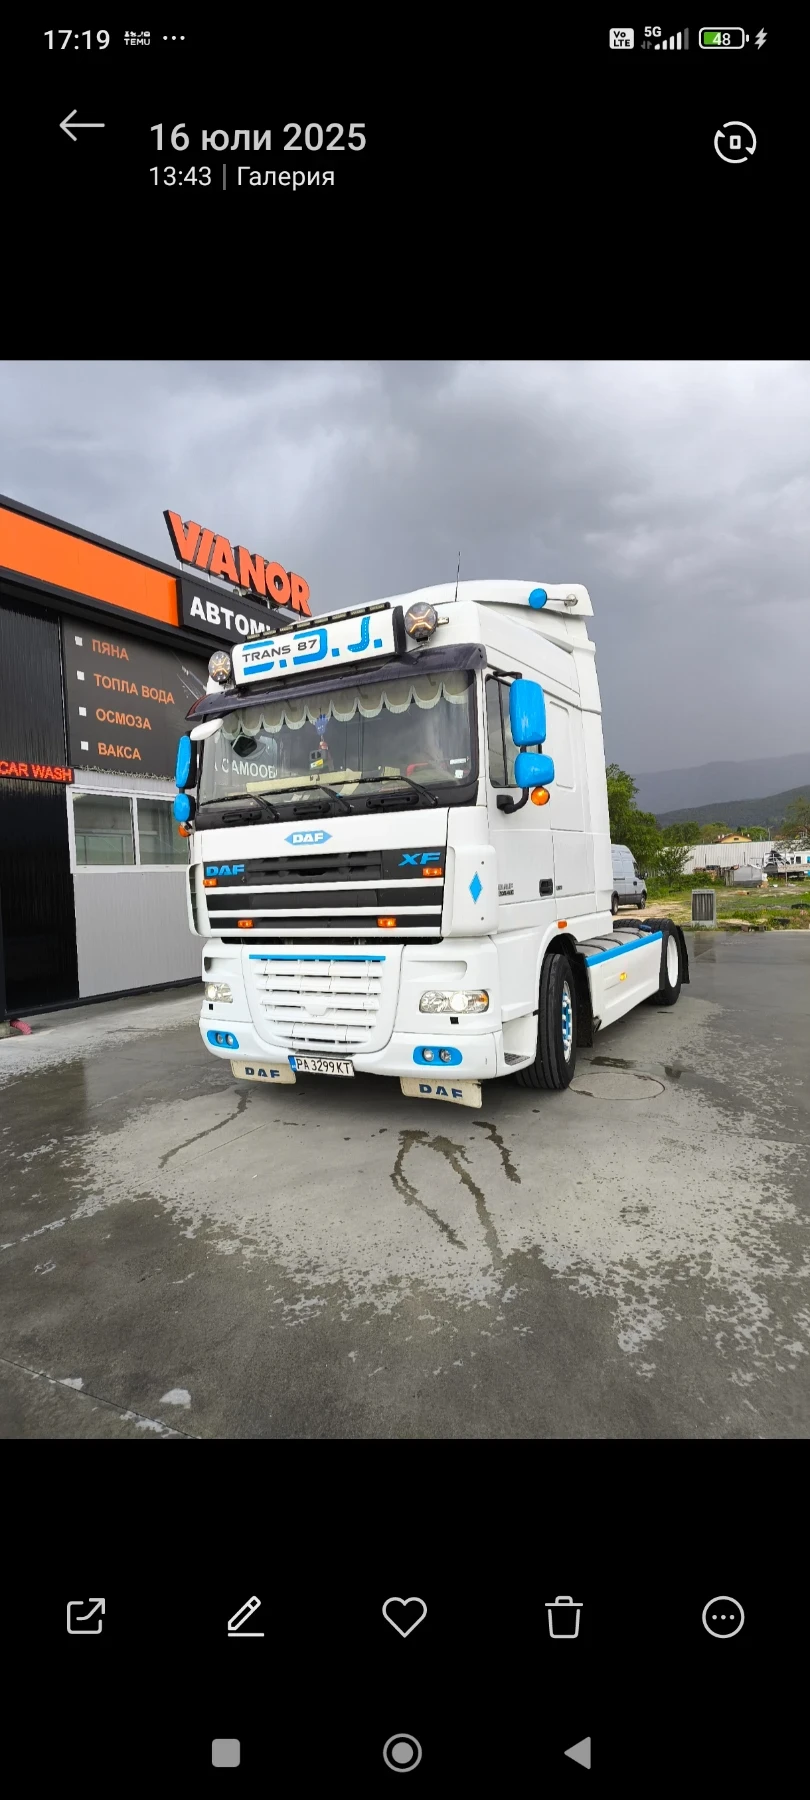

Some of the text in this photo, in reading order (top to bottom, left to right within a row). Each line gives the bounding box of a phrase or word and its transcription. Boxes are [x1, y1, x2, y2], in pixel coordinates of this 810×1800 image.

[164, 510, 312, 617] VIANOR
[190, 596, 271, 636] АВТОМ
[91, 638, 130, 661] ПЯНА
[242, 638, 318, 663] TRANS 87
[93, 673, 175, 704] ТОПЛА ВОДА
[95, 708, 152, 730] ОСМОЗА
[97, 742, 142, 761] ВАКСА
[0, 761, 73, 782] CAR WASH
[292, 832, 324, 843] DAF
[398, 852, 441, 867] XF
[206, 864, 245, 877] DAF
[244, 1066, 280, 1078] DAF
[418, 1083, 463, 1098] DAF
